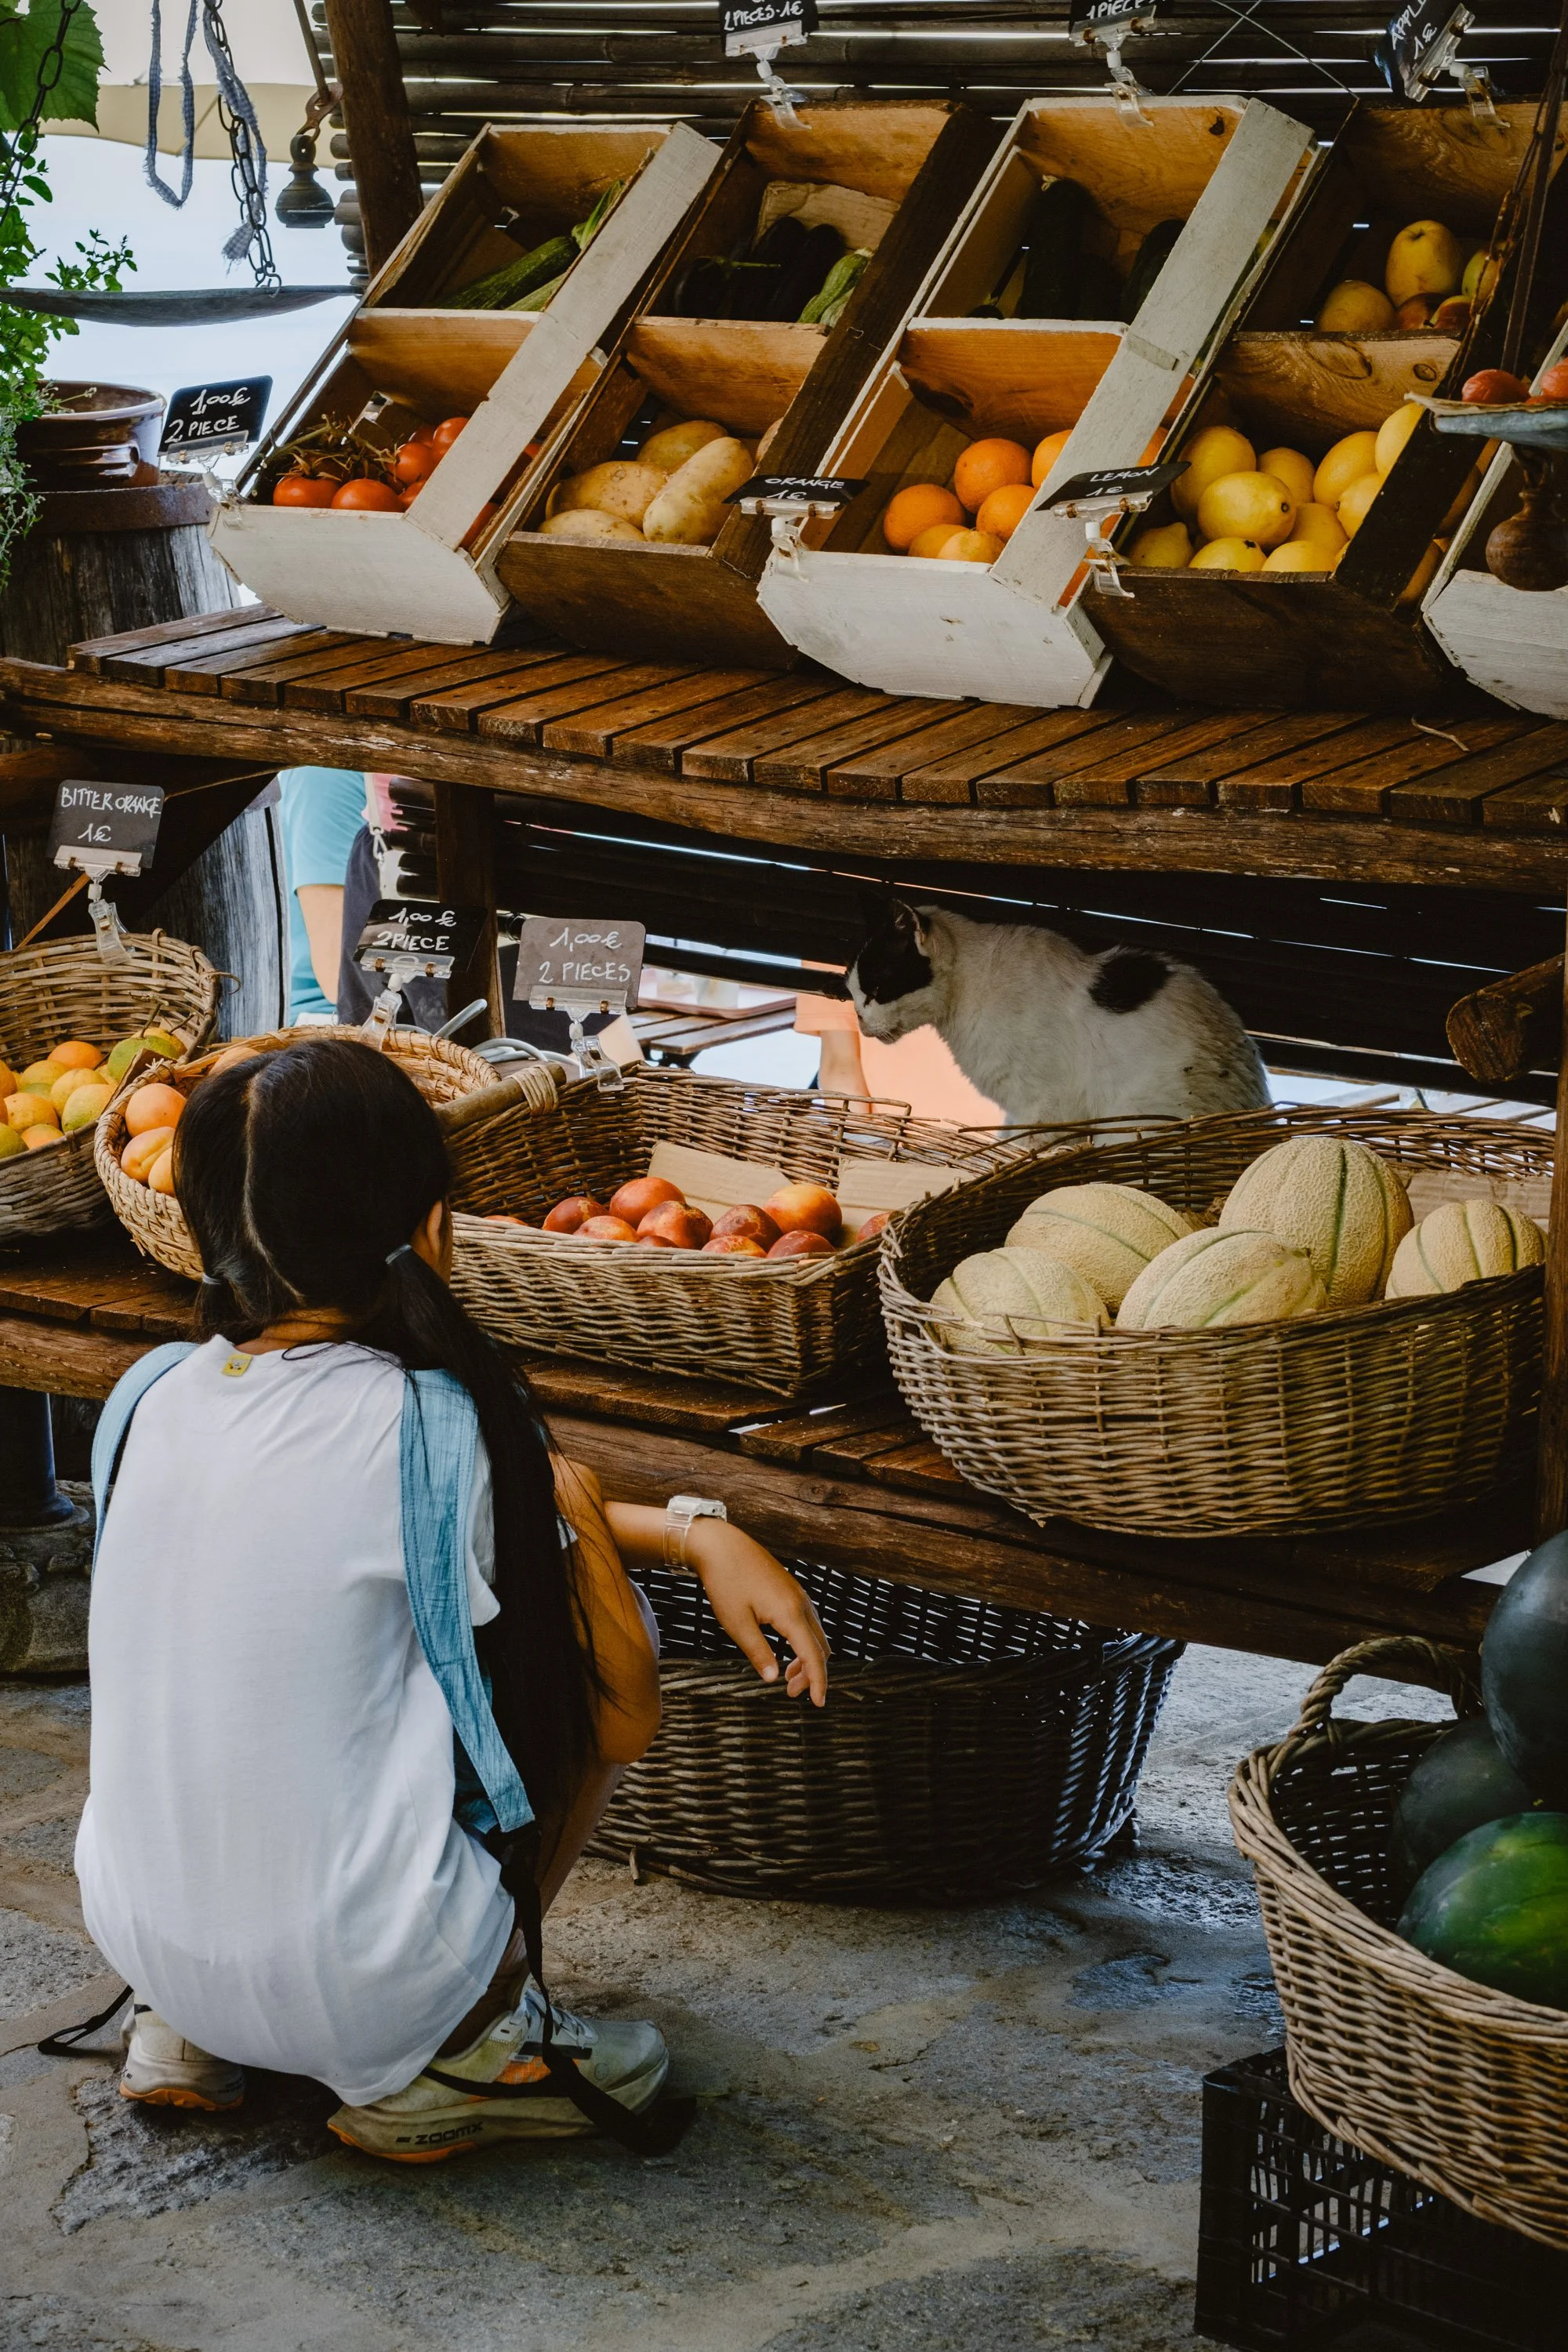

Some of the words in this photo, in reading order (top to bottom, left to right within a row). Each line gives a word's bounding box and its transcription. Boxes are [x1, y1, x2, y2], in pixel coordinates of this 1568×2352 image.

[190, 387, 251, 416] 1,00€
[164, 419, 184, 444] 2
[188, 416, 240, 437] PIECE
[764, 477, 845, 490] ORANGE
[1090, 467, 1160, 482] LEMON
[766, 490, 808, 501] 1€
[1086, 486, 1123, 497] 1€
[60, 786, 114, 811] BITTER
[114, 794, 162, 819] ORANGE
[78, 823, 111, 843] 1€
[550, 927, 622, 953] 1,00€
[539, 961, 554, 984] 2
[562, 961, 632, 983] PIECES
